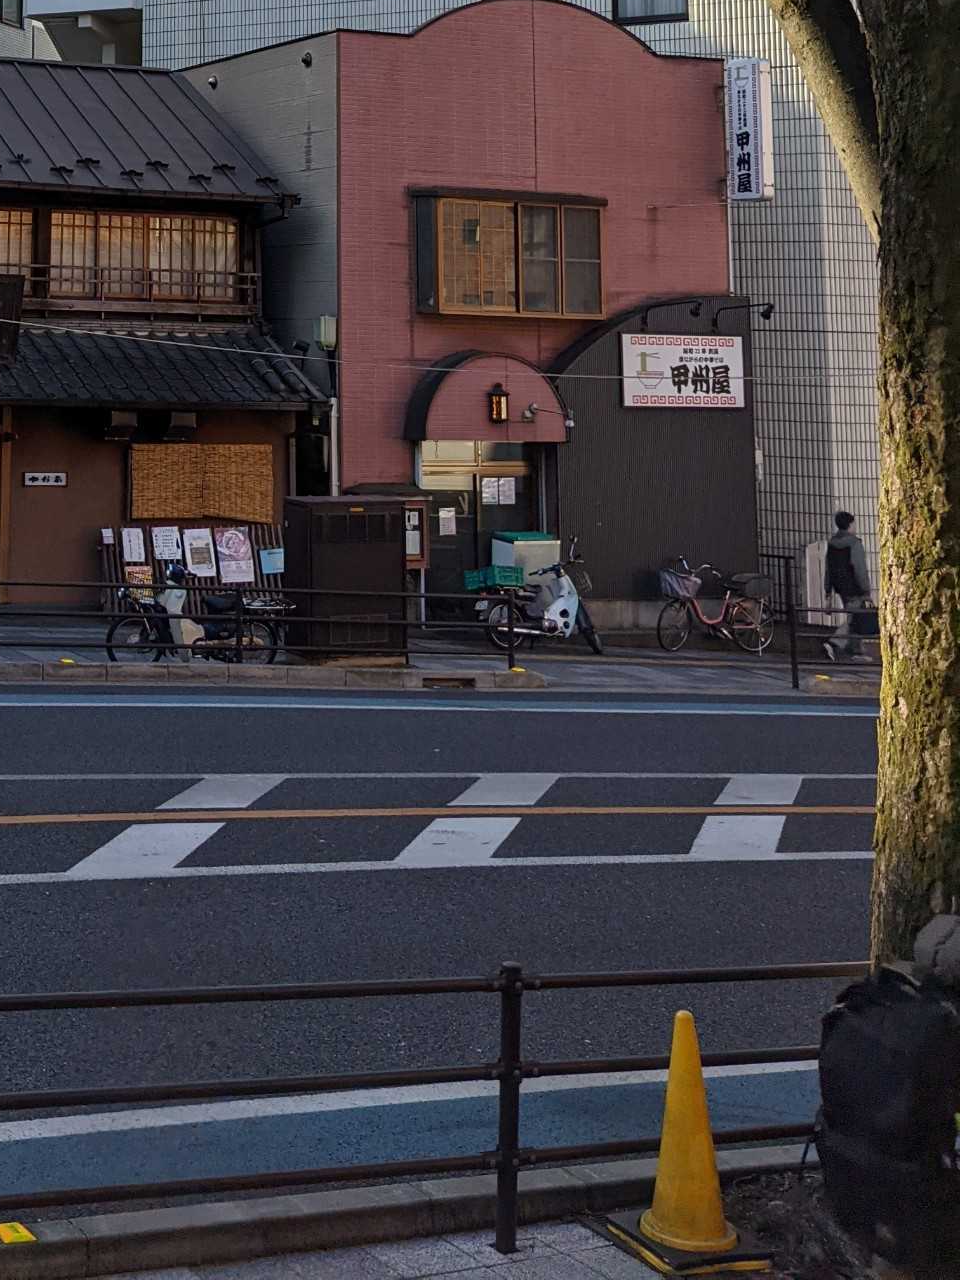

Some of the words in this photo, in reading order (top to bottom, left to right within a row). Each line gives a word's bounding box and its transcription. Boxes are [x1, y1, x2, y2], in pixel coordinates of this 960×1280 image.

[736, 131, 752, 193] 甲州屋
[670, 364, 731, 394] 甲州屋
